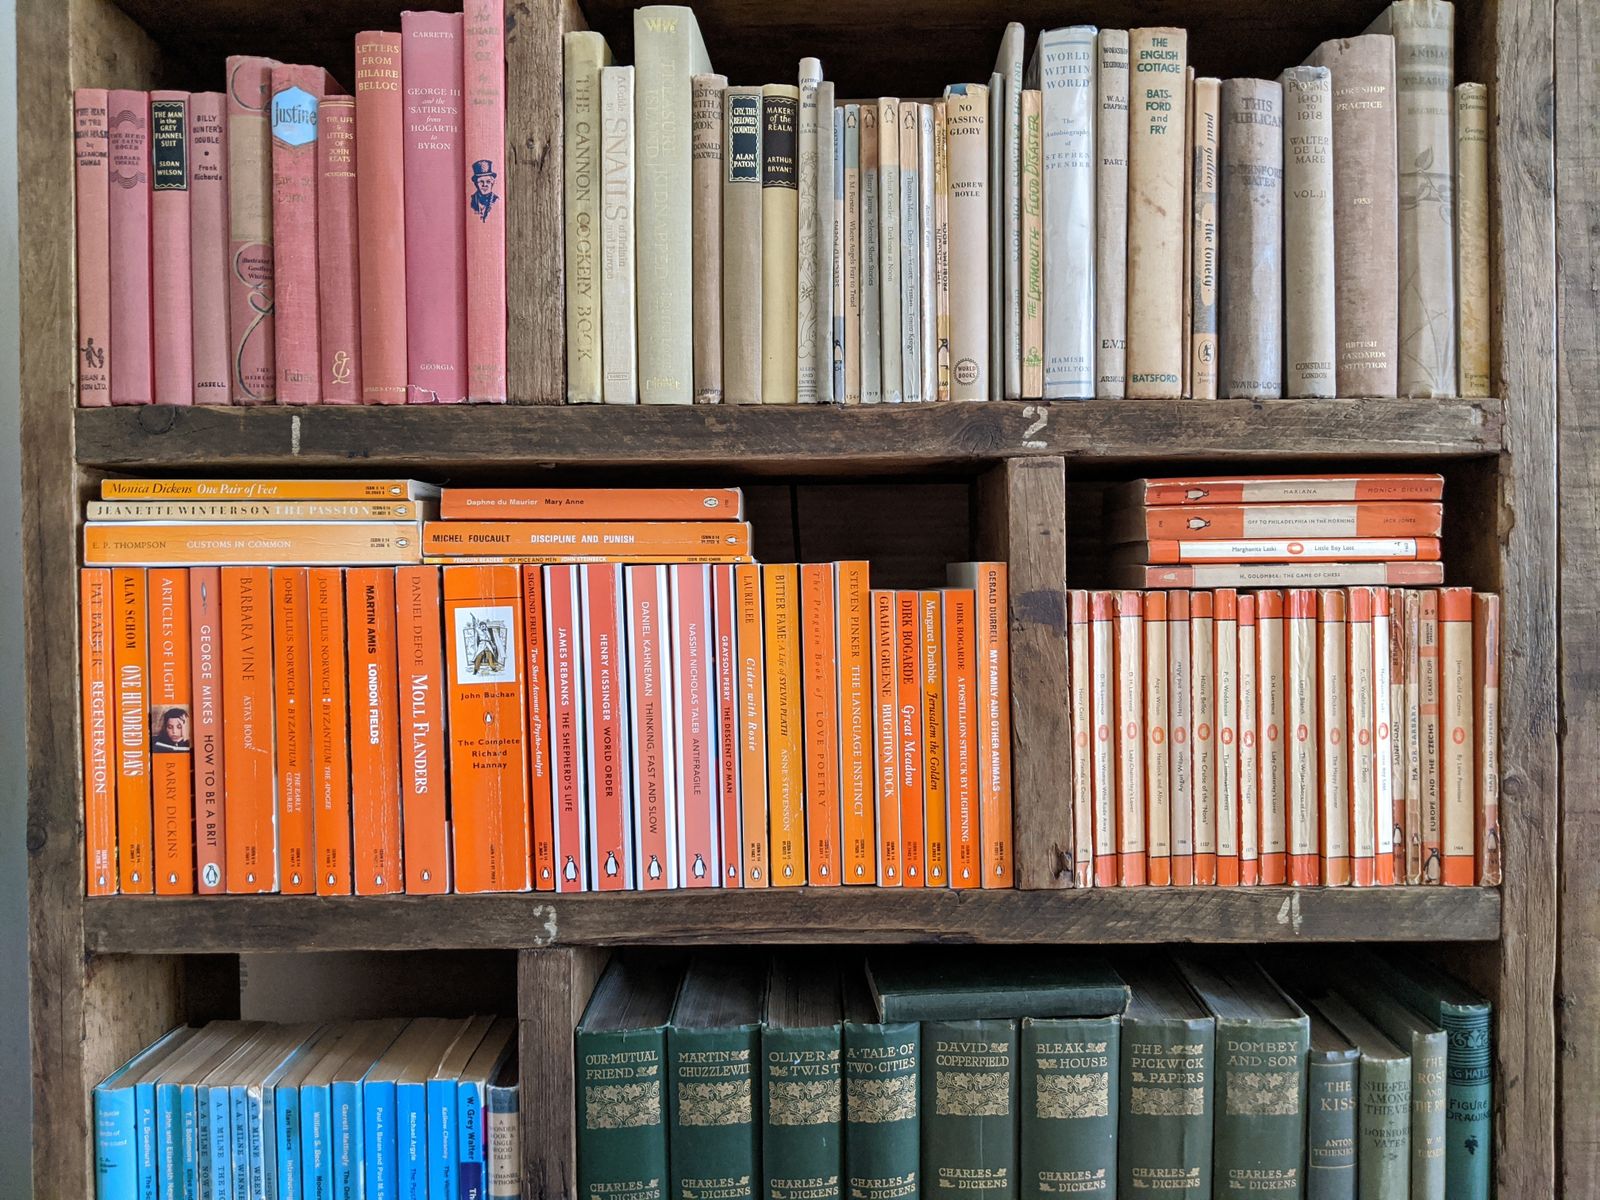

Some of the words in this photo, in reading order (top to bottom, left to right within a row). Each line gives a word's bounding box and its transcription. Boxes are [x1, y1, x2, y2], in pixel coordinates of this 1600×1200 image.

[413, 31, 454, 39] CARRETTA
[1152, 38, 1168, 47] THE
[357, 44, 399, 54] LETTERS
[1140, 49, 1178, 60] ENGLISH
[362, 56, 392, 65] FROM
[1046, 52, 1090, 62] WORLD
[1045, 65, 1090, 76] WITHIN
[1137, 62, 1180, 73] COTTAGE
[357, 69, 399, 79] HILAIRE
[358, 81, 397, 91] BELLOC
[1046, 78, 1090, 89] WORLD
[408, 87, 446, 96] GEORGE
[1147, 90, 1172, 99] BATS-
[767, 107, 794, 115] MAKERS
[959, 104, 972, 112] NO
[1146, 101, 1171, 111] FORD
[769, 115, 776, 123] of
[947, 115, 983, 124] PASSING
[1150, 114, 1168, 122] and
[411, 124, 458, 133] HOGARTH
[768, 123, 793, 132] REALM
[950, 127, 981, 135] GLORY
[1151, 125, 1167, 135] FRY
[1204, 112, 1214, 141] paul
[418, 142, 450, 150] BYRON
[768, 165, 792, 173] BRYANT
[955, 190, 980, 198] BOYLE
[1133, 373, 1177, 383] BATSFORD
[1022, 406, 1048, 448] 2
[110, 484, 149, 493] Monica
[152, 484, 192, 493] Dickens
[197, 484, 217, 493] One
[220, 484, 243, 493] Pair
[245, 484, 256, 497] of
[258, 484, 278, 494] Feet
[531, 535, 576, 543] DISCIPLINE
[582, 535, 598, 543] AND
[603, 535, 634, 543] PUNISH
[124, 576, 135, 605] ALAN
[743, 575, 754, 606] LAURIE
[849, 571, 860, 612] STEVEN
[366, 585, 376, 624] MARTIN
[412, 576, 423, 622] DANIEL
[641, 602, 652, 636] DANIEL
[744, 609, 755, 623] LEE
[126, 610, 136, 648] SCHOM
[367, 628, 377, 653] AMIS
[850, 617, 861, 657] PINKER
[200, 625, 212, 679] GEORGE
[413, 626, 424, 666] DEFOE
[721, 636, 730, 675] GRAYSON
[642, 640, 653, 696] KAHNEMAN
[745, 657, 757, 689] Cider
[121, 665, 141, 688] ONE
[851, 665, 861, 688] THE
[368, 664, 378, 706] LONDON
[722, 678, 730, 700] PERRY
[411, 674, 429, 717] MOLL
[202, 686, 213, 724] MIKES
[747, 692, 758, 717] with
[122, 692, 142, 745] HUNDRED
[723, 707, 732, 720] THE
[369, 709, 379, 744] FIELDS
[644, 702, 655, 752] THINKING,
[851, 692, 863, 757] LANGUAGE
[723, 723, 732, 757] DESCENT
[747, 721, 758, 751] Rosie
[204, 735, 214, 765] HOW
[124, 751, 143, 776] DAYS
[413, 723, 429, 793] FLANDERS
[646, 755, 656, 778] FAST
[725, 760, 733, 771] OF
[1428, 759, 1436, 775] THE
[205, 770, 215, 785] TO
[725, 774, 733, 793] MAN
[647, 782, 657, 803] AND
[853, 761, 864, 816] INSTINCT
[1428, 778, 1436, 797] AND
[205, 792, 215, 804] BE
[207, 810, 216, 818] A
[648, 806, 658, 833] SLOW
[1429, 802, 1437, 832] EUROPE
[207, 823, 217, 846] BRIT
[1277, 892, 1302, 934] 4
[936, 1042, 988, 1053] DAVID
[1036, 1043, 1084, 1054] BLEAK
[1132, 1044, 1162, 1054] THE
[769, 1052, 824, 1063] OLIVER
[936, 1056, 1009, 1066] COPPERFIELD
[1060, 1057, 1108, 1068] HOUSE
[1132, 1057, 1203, 1068] PICKWICK
[791, 1064, 840, 1077] TWIST
[1150, 1072, 1203, 1083] PAPERS
[1325, 1081, 1352, 1092] THE
[467, 1097, 474, 1106] W.
[466, 1109, 475, 1130] Grey
[939, 1168, 992, 1178] CHARLES
[1039, 1172, 1091, 1181] CHARLES
[1133, 1168, 1185, 1178] CHARLES
[770, 1178, 822, 1188] CHARLES
[958, 1178, 1007, 1189] DICKENS
[1059, 1181, 1106, 1192] DICKENS
[1152, 1178, 1200, 1189] DICKENS
[790, 1188, 838, 1199] DICKENS
